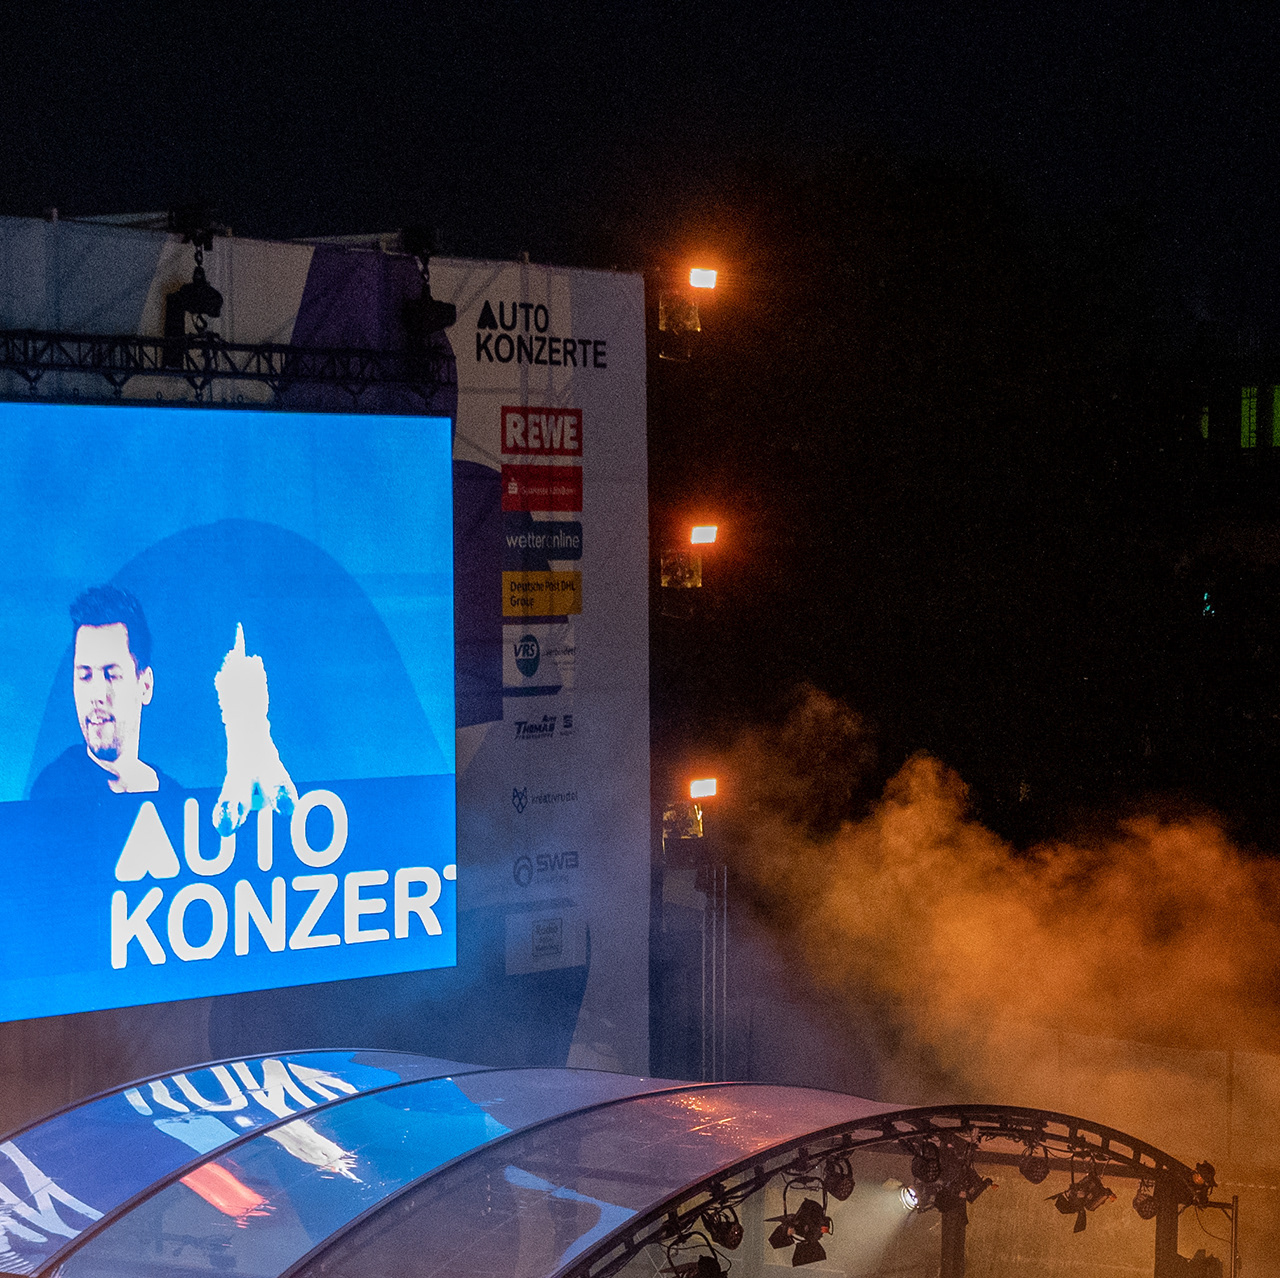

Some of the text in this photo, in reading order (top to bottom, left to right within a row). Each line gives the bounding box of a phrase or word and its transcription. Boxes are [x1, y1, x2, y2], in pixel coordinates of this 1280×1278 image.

[477, 300, 549, 333] AUTO
[476, 332, 608, 369] KONZERTE
[506, 413, 579, 450] REWE
[505, 529, 580, 549] wetteronline
[513, 642, 536, 658] VRS
[536, 851, 580, 872] SWB
[110, 864, 457, 970] KONZER
